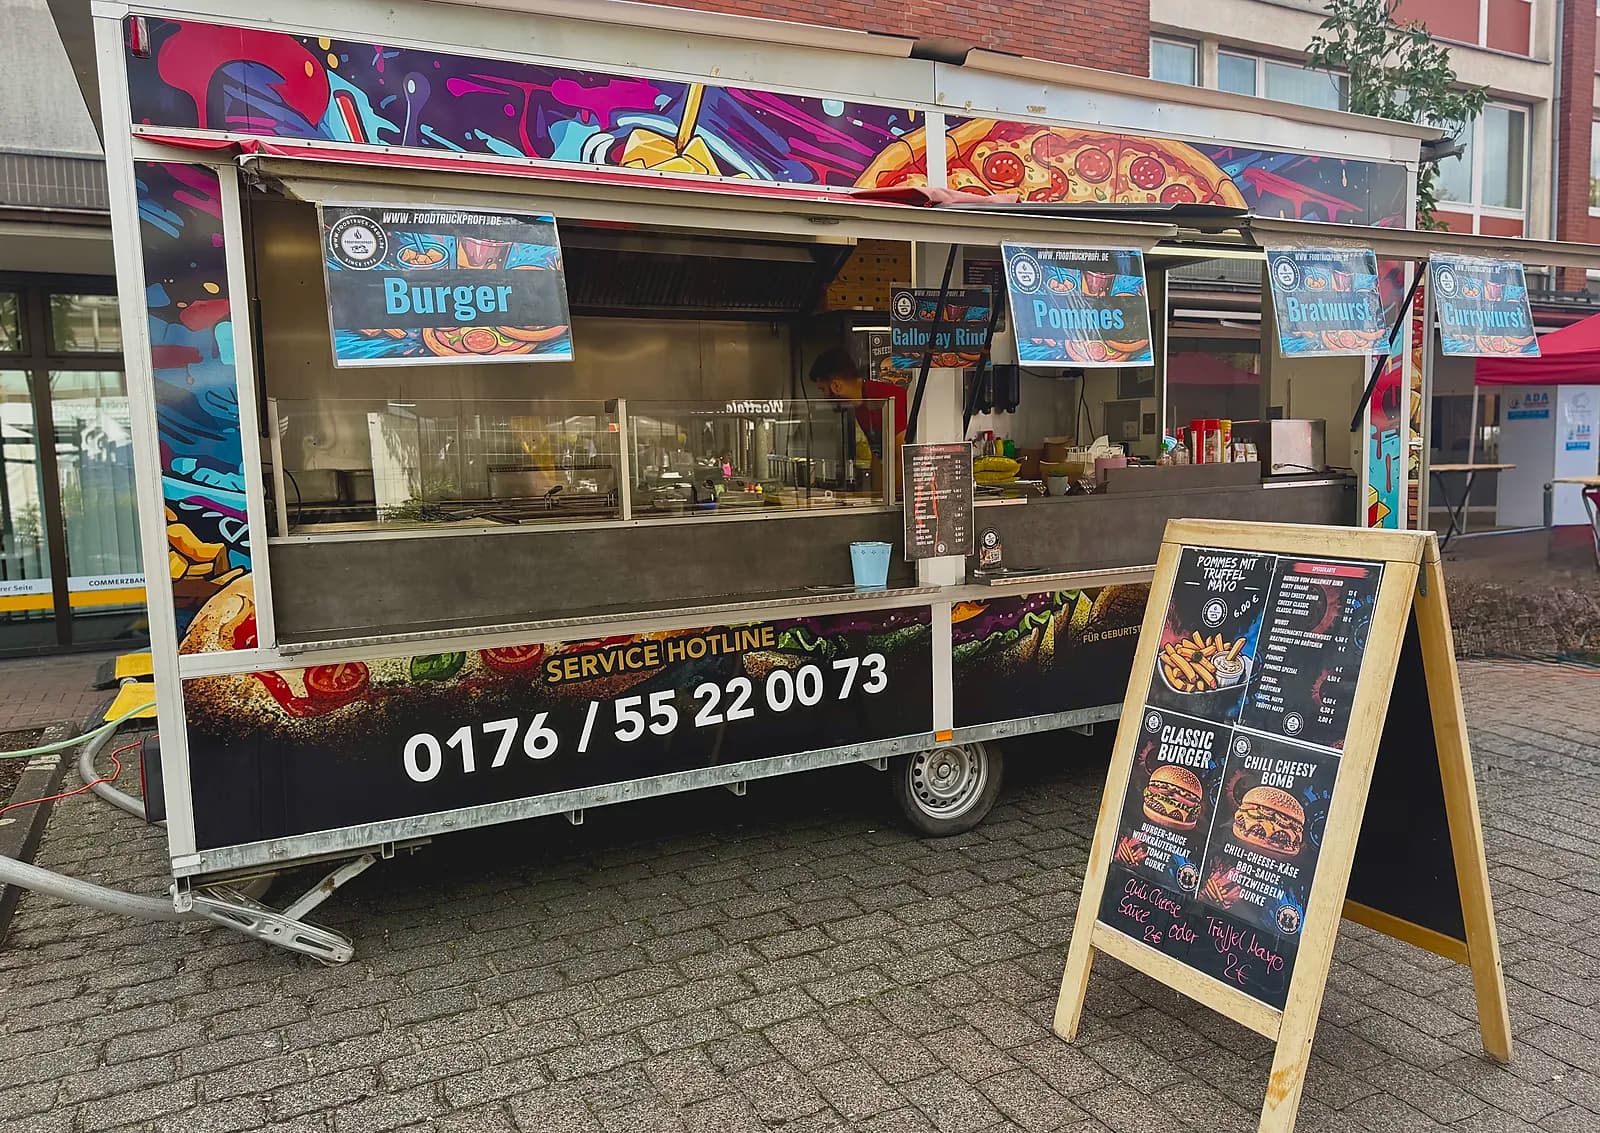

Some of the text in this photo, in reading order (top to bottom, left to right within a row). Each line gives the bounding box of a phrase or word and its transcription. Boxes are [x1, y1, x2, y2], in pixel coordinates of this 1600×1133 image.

[383, 277, 512, 321] Burger
[1286, 297, 1373, 323] Bratwurst
[1033, 299, 1125, 331] Pommes
[1443, 302, 1526, 332] Currywurst
[956, 327, 988, 346] Rind
[1525, 393, 1549, 402] ADA
[1196, 556, 1259, 571] POMMES MIT
[13, 584, 33, 592] Seite
[1207, 579, 1237, 593] MAYO
[1082, 631, 1100, 644] FÜR
[547, 626, 776, 683] SERVICE HOTLINE
[403, 652, 888, 783] 0176 / 55 22 00 73
[1160, 724, 1215, 750] CLASSIC
[1157, 743, 1212, 769] BURGER
[1244, 755, 1318, 778] CHILI CHEESY
[1260, 771, 1295, 789] BOMB
[1141, 822, 1188, 846] BURGER-SAUCE
[1144, 857, 1166, 873] GURKE
[1146, 846, 1172, 863] TOMATE
[1223, 843, 1300, 879] CHILI-CHEESE-KÄSE
[1235, 860, 1281, 885] BBQ-SAUCE
[1239, 888, 1267, 907] GURKE
[1143, 925, 1163, 944] 2€
[1246, 933, 1284, 975] Mayo
[1224, 952, 1252, 985] 2€
